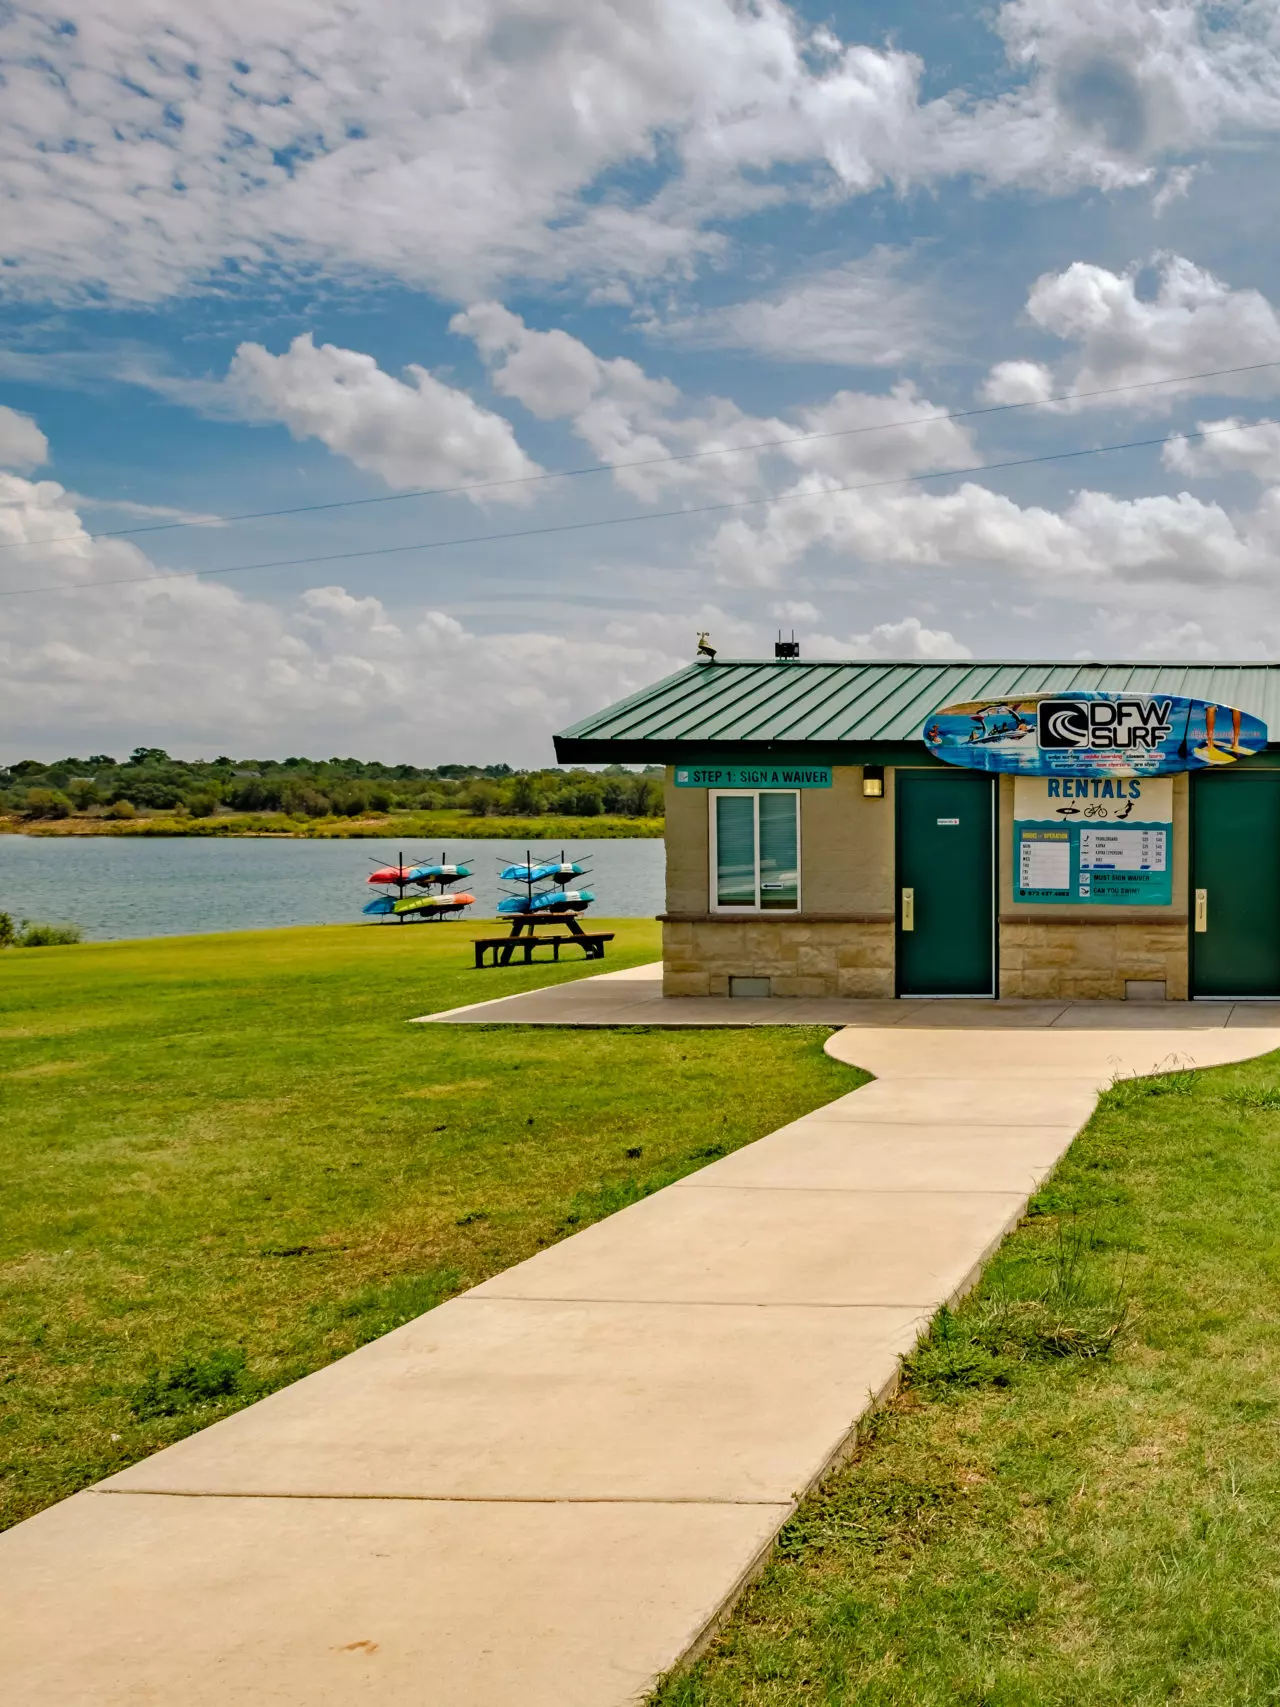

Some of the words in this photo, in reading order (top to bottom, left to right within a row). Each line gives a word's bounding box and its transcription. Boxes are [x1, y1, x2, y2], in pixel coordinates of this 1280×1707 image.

[1090, 702, 1171, 726] DFW
[1090, 726, 1171, 748] SURF
[693, 771, 722, 783] STEP
[726, 771, 736, 783] 1:
[740, 771, 768, 783] SIGN
[771, 771, 779, 783] A
[782, 771, 828, 783] WAIVER
[1047, 778, 1141, 799] RENTALS
